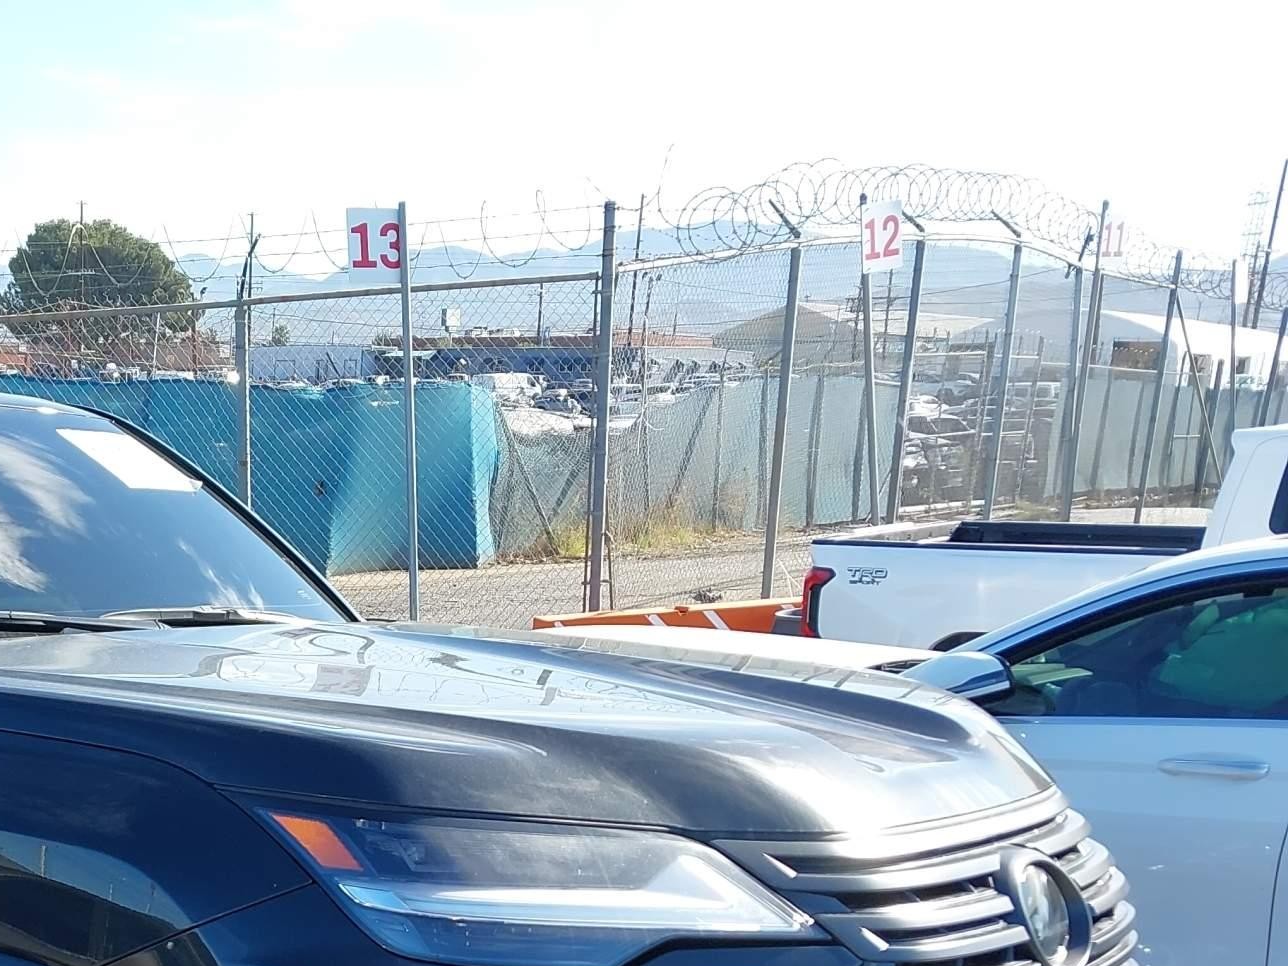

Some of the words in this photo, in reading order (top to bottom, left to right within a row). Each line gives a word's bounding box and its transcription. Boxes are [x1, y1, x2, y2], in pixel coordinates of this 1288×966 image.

[350, 222, 401, 269] 13
[864, 214, 900, 261] 12
[1101, 221, 1125, 257] 11
[847, 566, 888, 583] TRD
